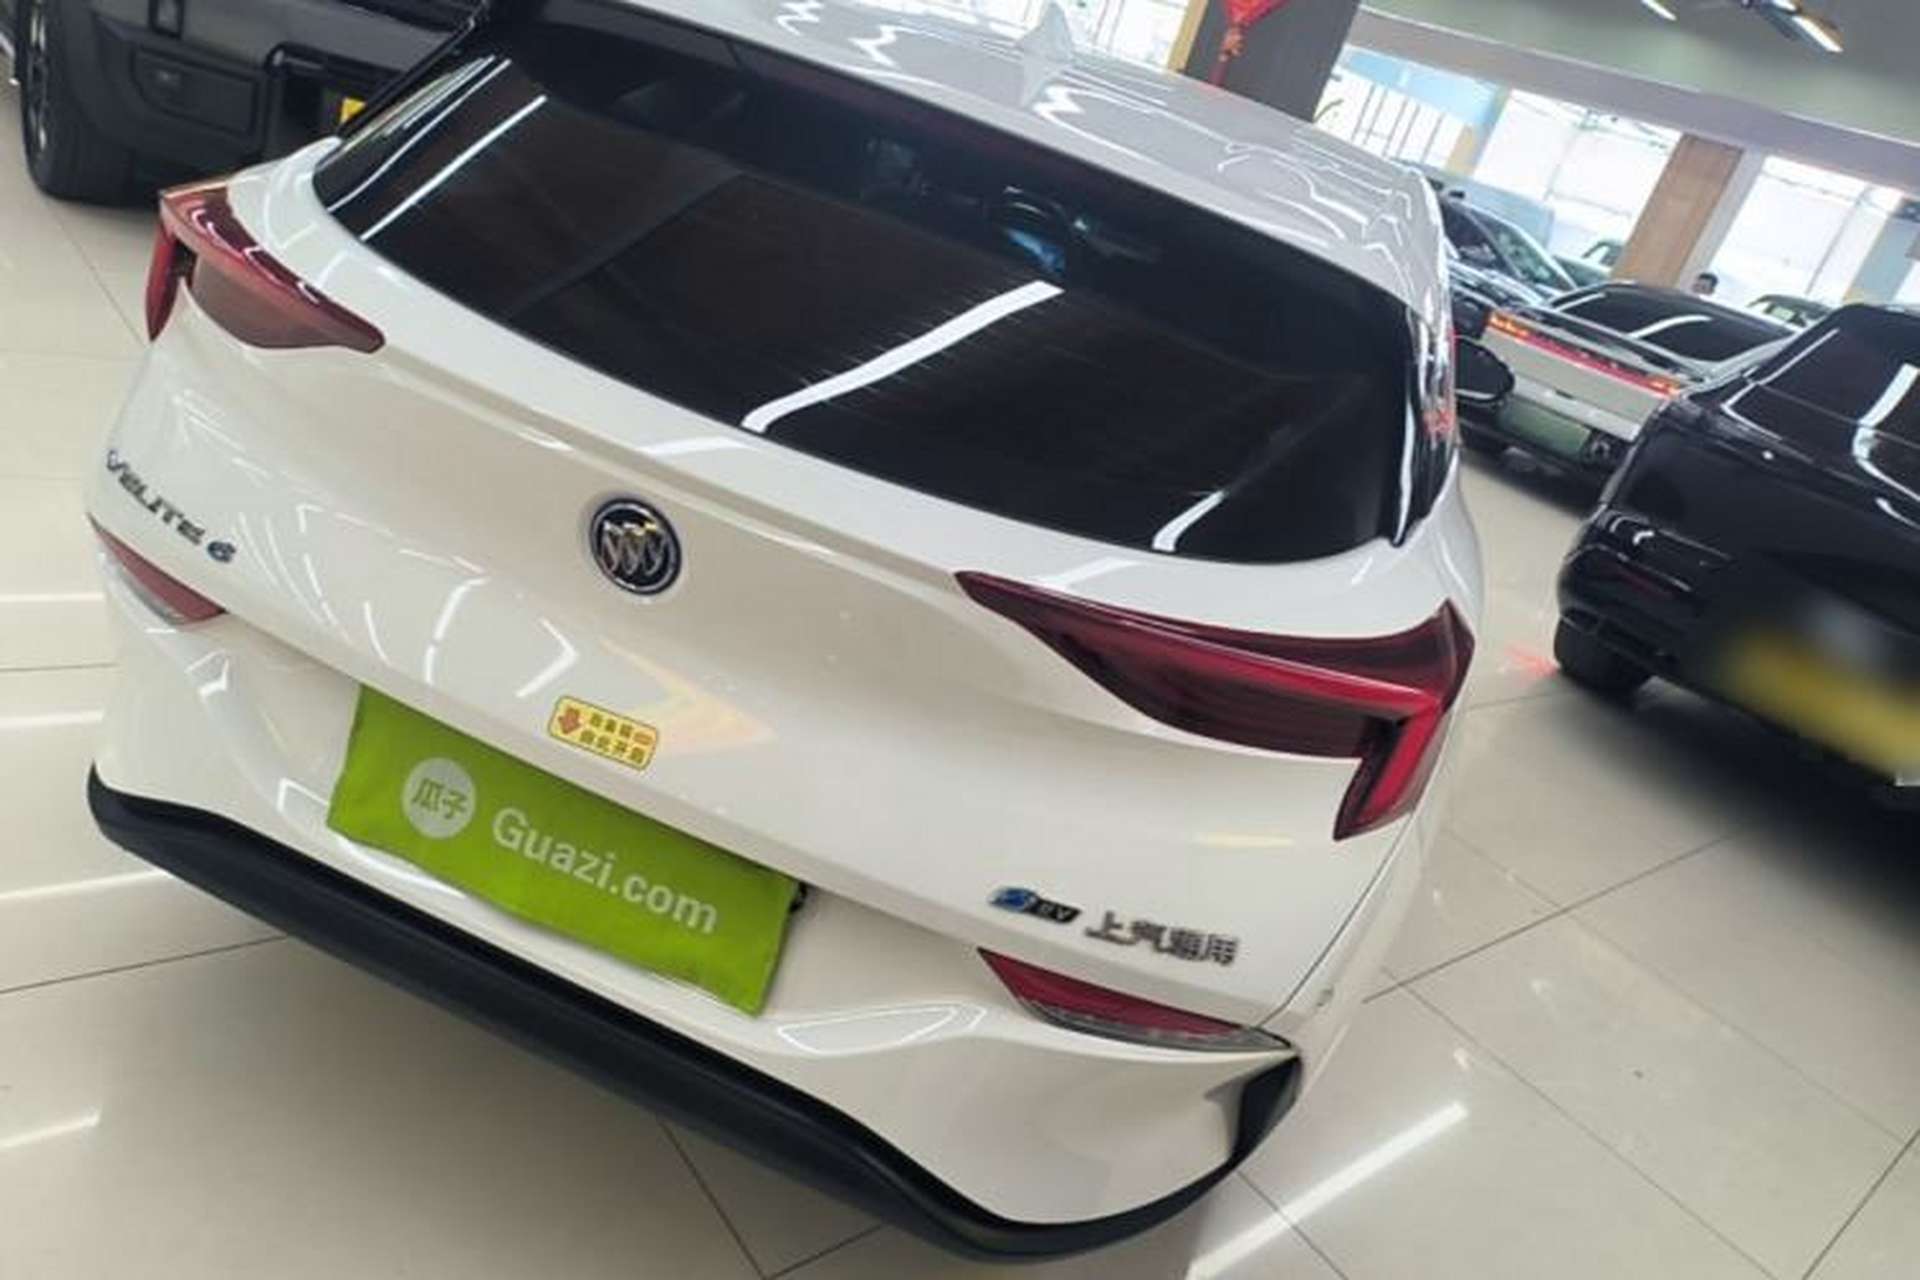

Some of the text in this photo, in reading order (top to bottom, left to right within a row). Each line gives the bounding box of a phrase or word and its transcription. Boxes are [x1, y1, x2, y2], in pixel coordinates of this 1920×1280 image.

[207, 540, 237, 562] 6
[412, 778, 469, 821] 瓜子
[492, 807, 718, 935] Guazi.com
